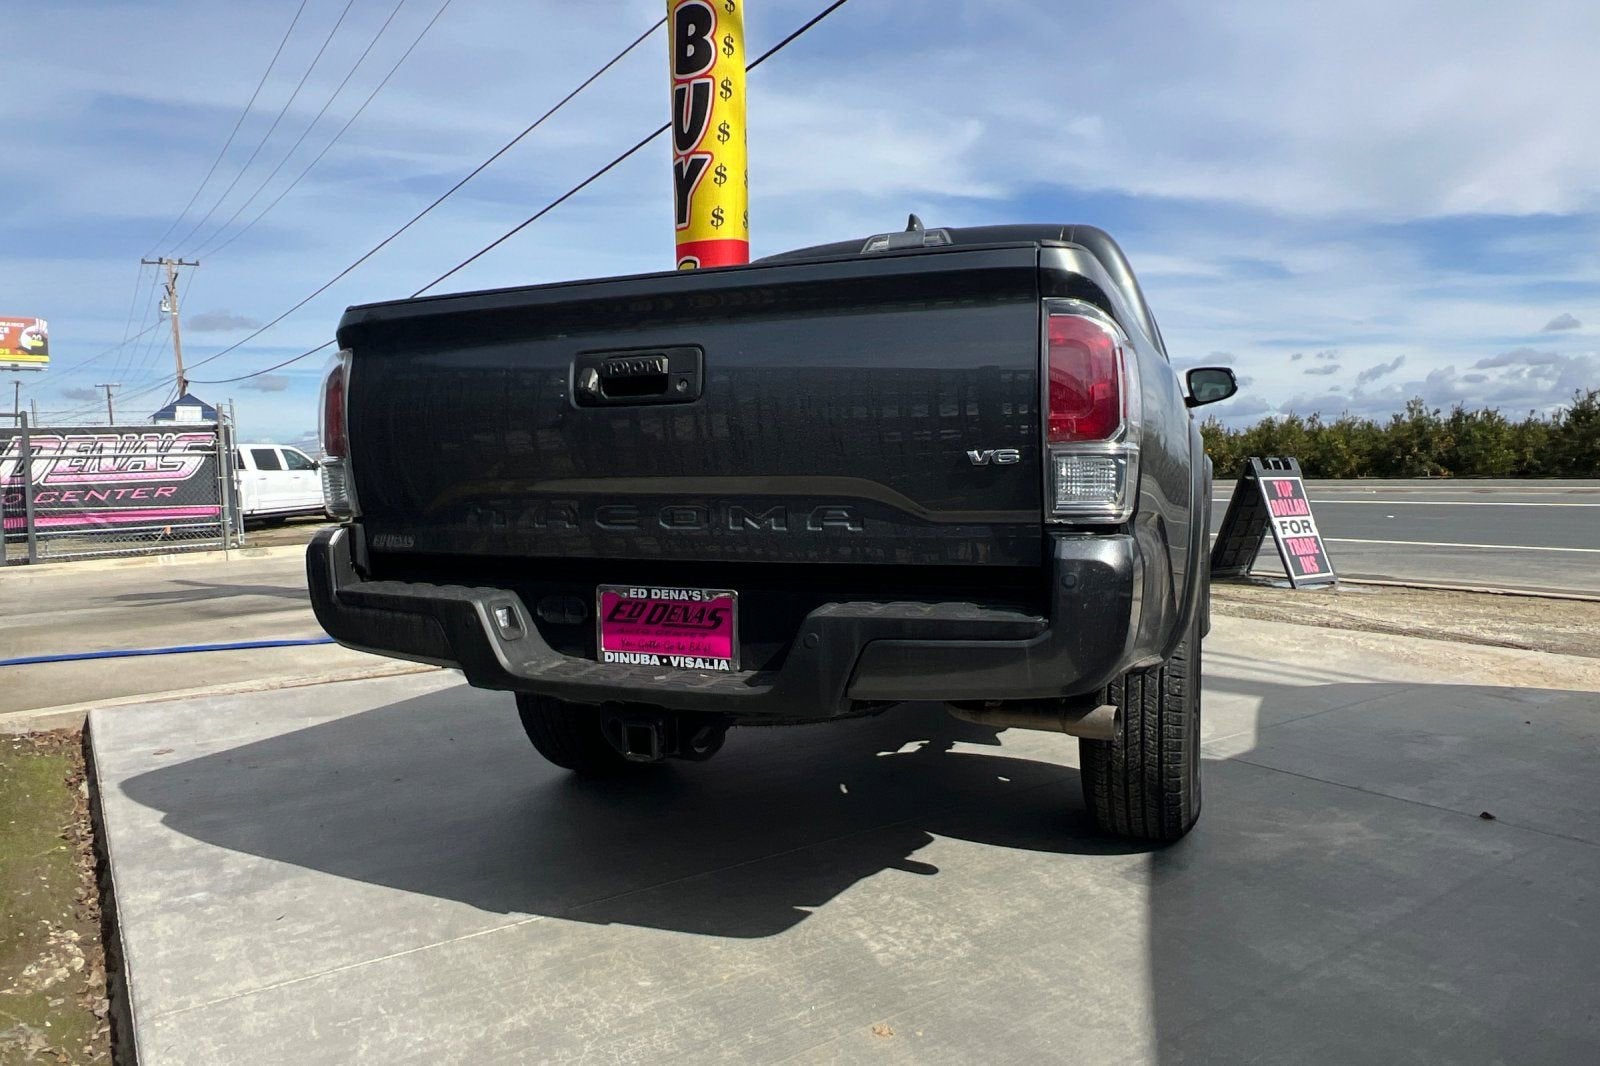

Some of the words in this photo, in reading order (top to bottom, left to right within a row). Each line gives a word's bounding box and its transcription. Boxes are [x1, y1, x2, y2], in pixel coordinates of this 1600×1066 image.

[672, 1, 716, 229] BUY
[966, 448, 1020, 466] V6
[34, 486, 178, 504] CENTER
[1272, 480, 1293, 498] TOP
[1270, 498, 1309, 516] DOLLAR
[472, 504, 865, 532] TACOMA
[1279, 520, 1314, 535] FOR
[1286, 538, 1320, 556] TRADE
[1299, 555, 1319, 574] INS
[629, 588, 648, 599] ED
[650, 589, 702, 601] DENA'S
[607, 601, 647, 623] ED
[604, 651, 661, 666] DINUBA
[669, 655, 730, 671] VISALIA
